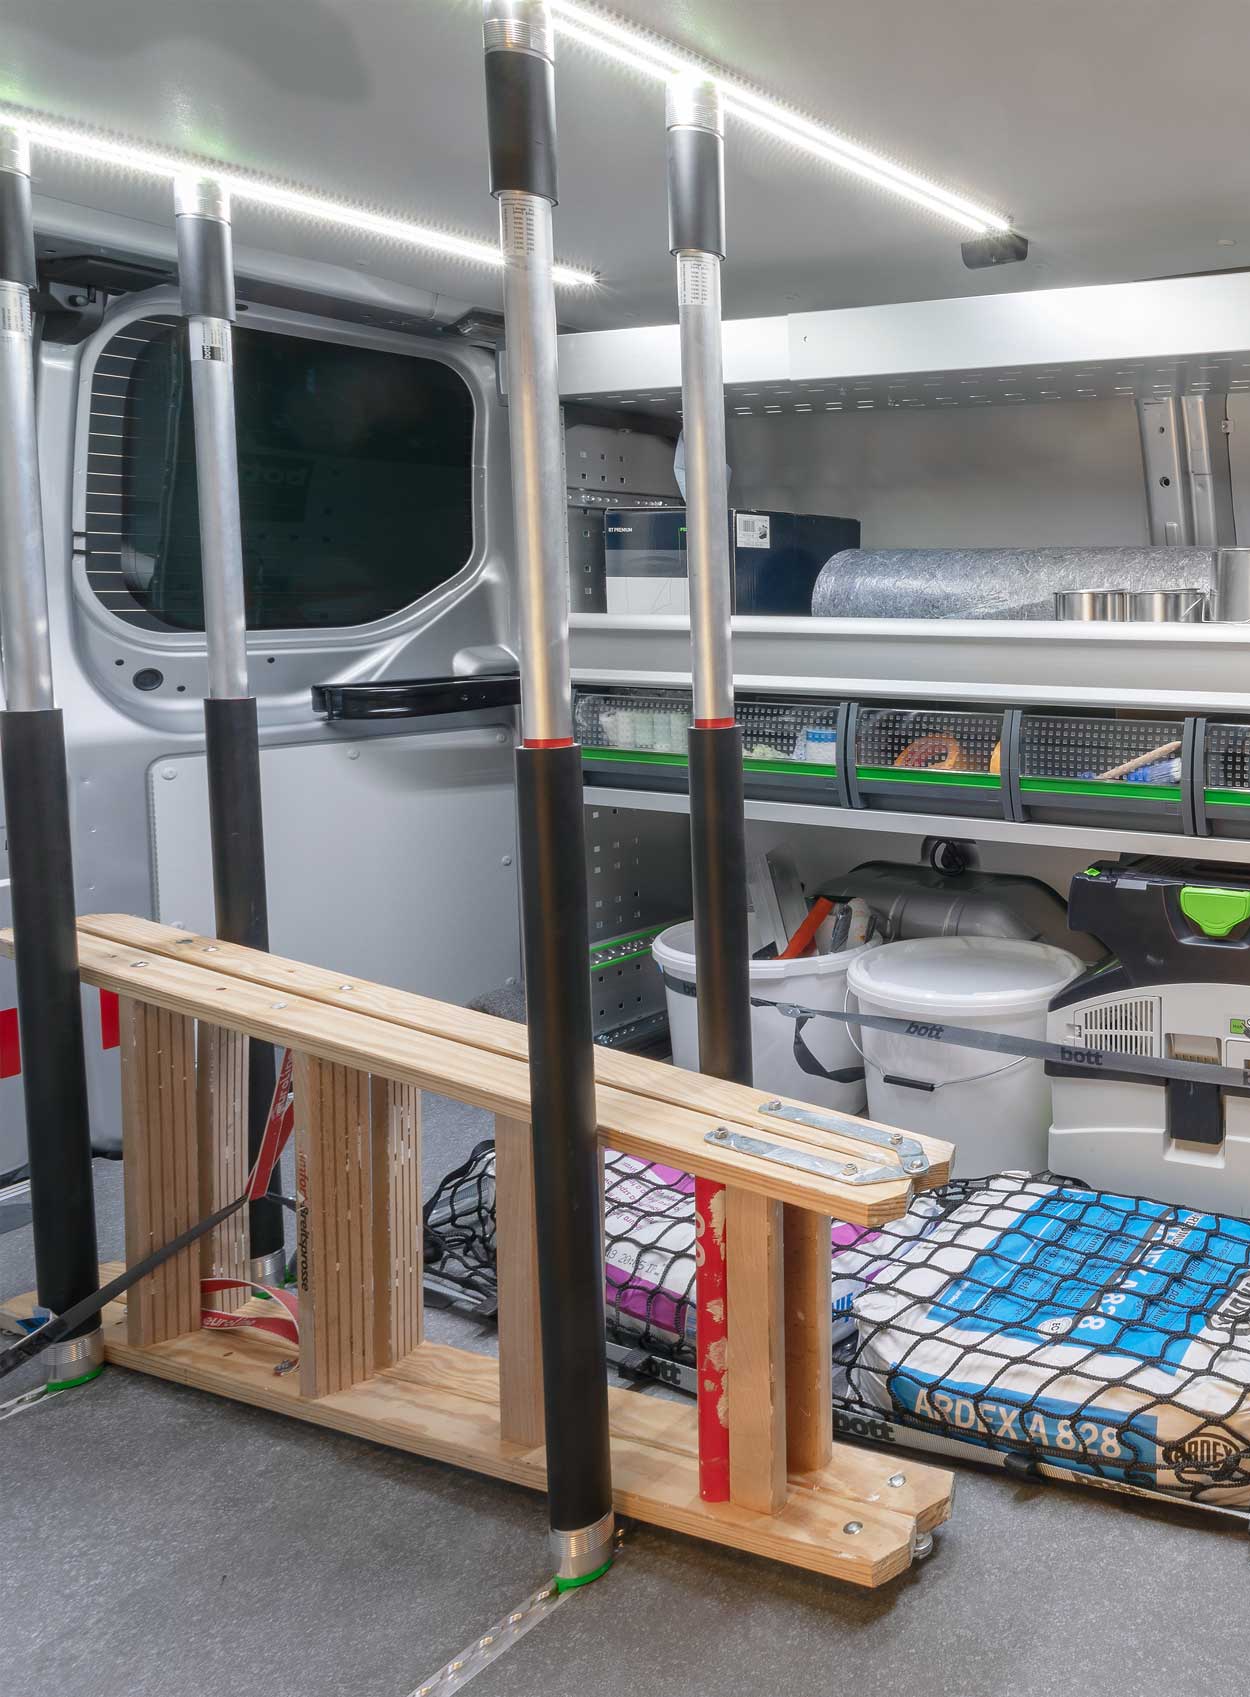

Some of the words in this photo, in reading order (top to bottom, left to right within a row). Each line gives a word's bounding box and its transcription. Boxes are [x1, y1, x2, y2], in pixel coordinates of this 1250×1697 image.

[904, 1022, 945, 1040] bott
[1060, 1047, 1103, 1066] bott
[914, 1388, 1019, 1441] ARDEX
[1026, 1414, 1049, 1446] A
[1055, 1419, 1122, 1459] 828
